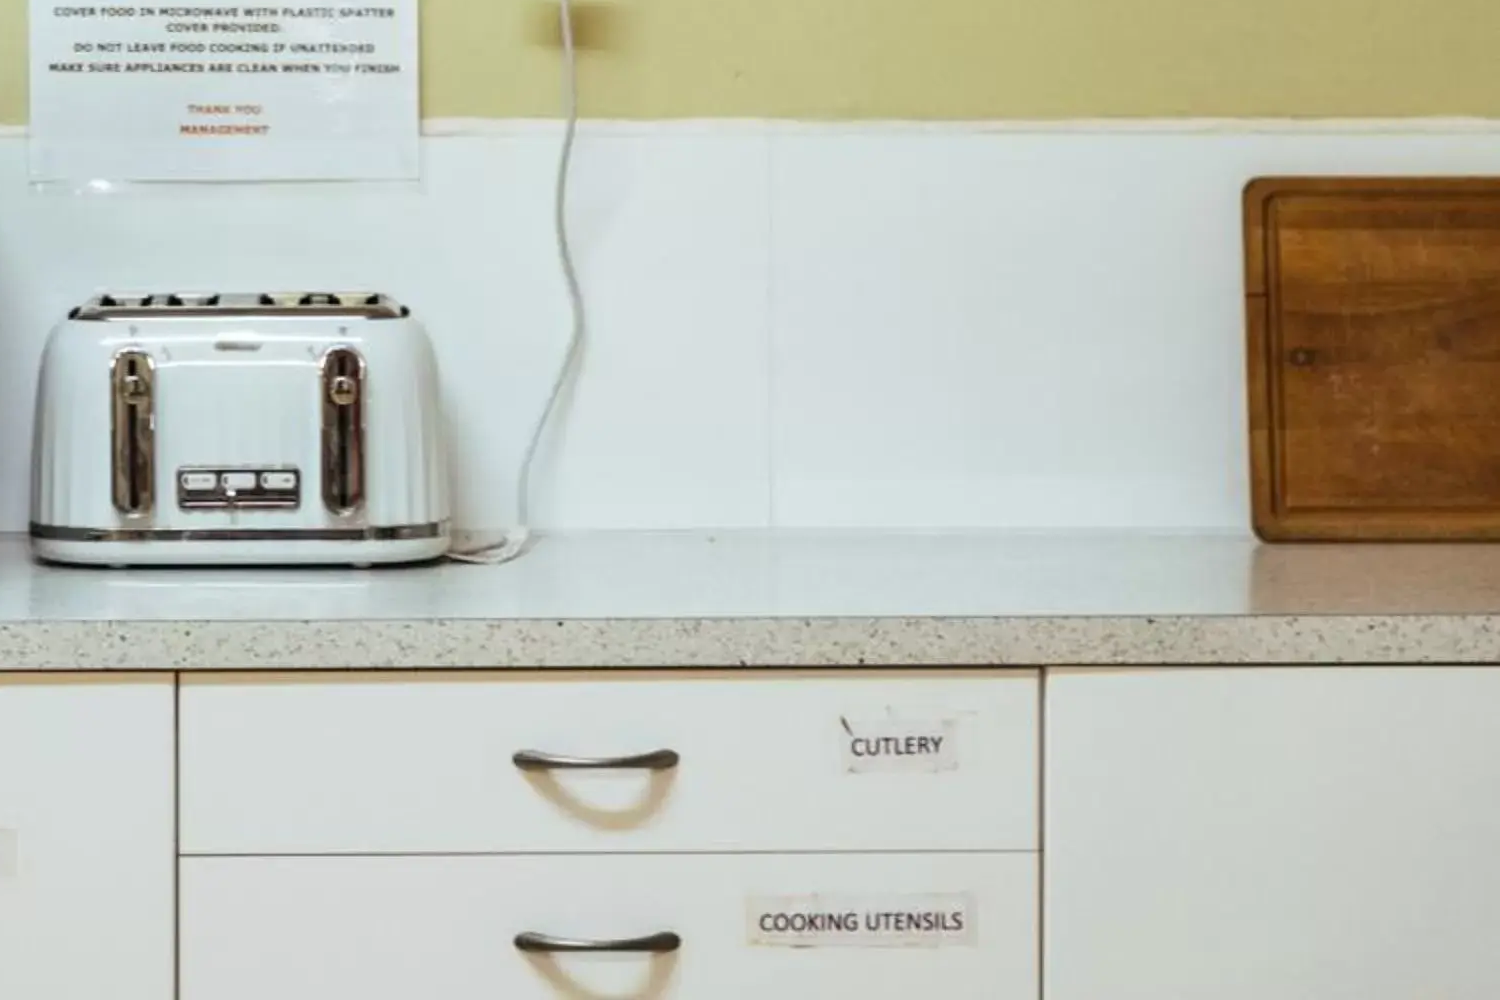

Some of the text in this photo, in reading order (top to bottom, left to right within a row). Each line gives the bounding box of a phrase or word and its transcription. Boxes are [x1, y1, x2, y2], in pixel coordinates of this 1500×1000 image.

[53, 6, 97, 18] COVER
[100, 6, 136, 18] FOOD
[139, 6, 156, 18] IN
[158, 6, 239, 18] MICROWAVE
[243, 6, 279, 18] WITH
[281, 6, 335, 19] PLASTIC
[165, 22, 209, 34] COVER
[73, 42, 94, 54] DO
[96, 42, 123, 54] NOT
[126, 42, 166, 54] LEAVE
[169, 42, 207, 54] FOOD
[208, 42, 269, 54] COOKING
[289, 42, 375, 54] UNATTENDED
[48, 62, 401, 74] MAKE SURE APPLIANCES ARE CLEAN WHEN YOU FINISH
[186, 103, 231, 115] THANK
[179, 124, 271, 136] MANAGEMENT
[850, 735, 944, 757] CUTLERY
[758, 911, 964, 933] COOKING UTENSILS
